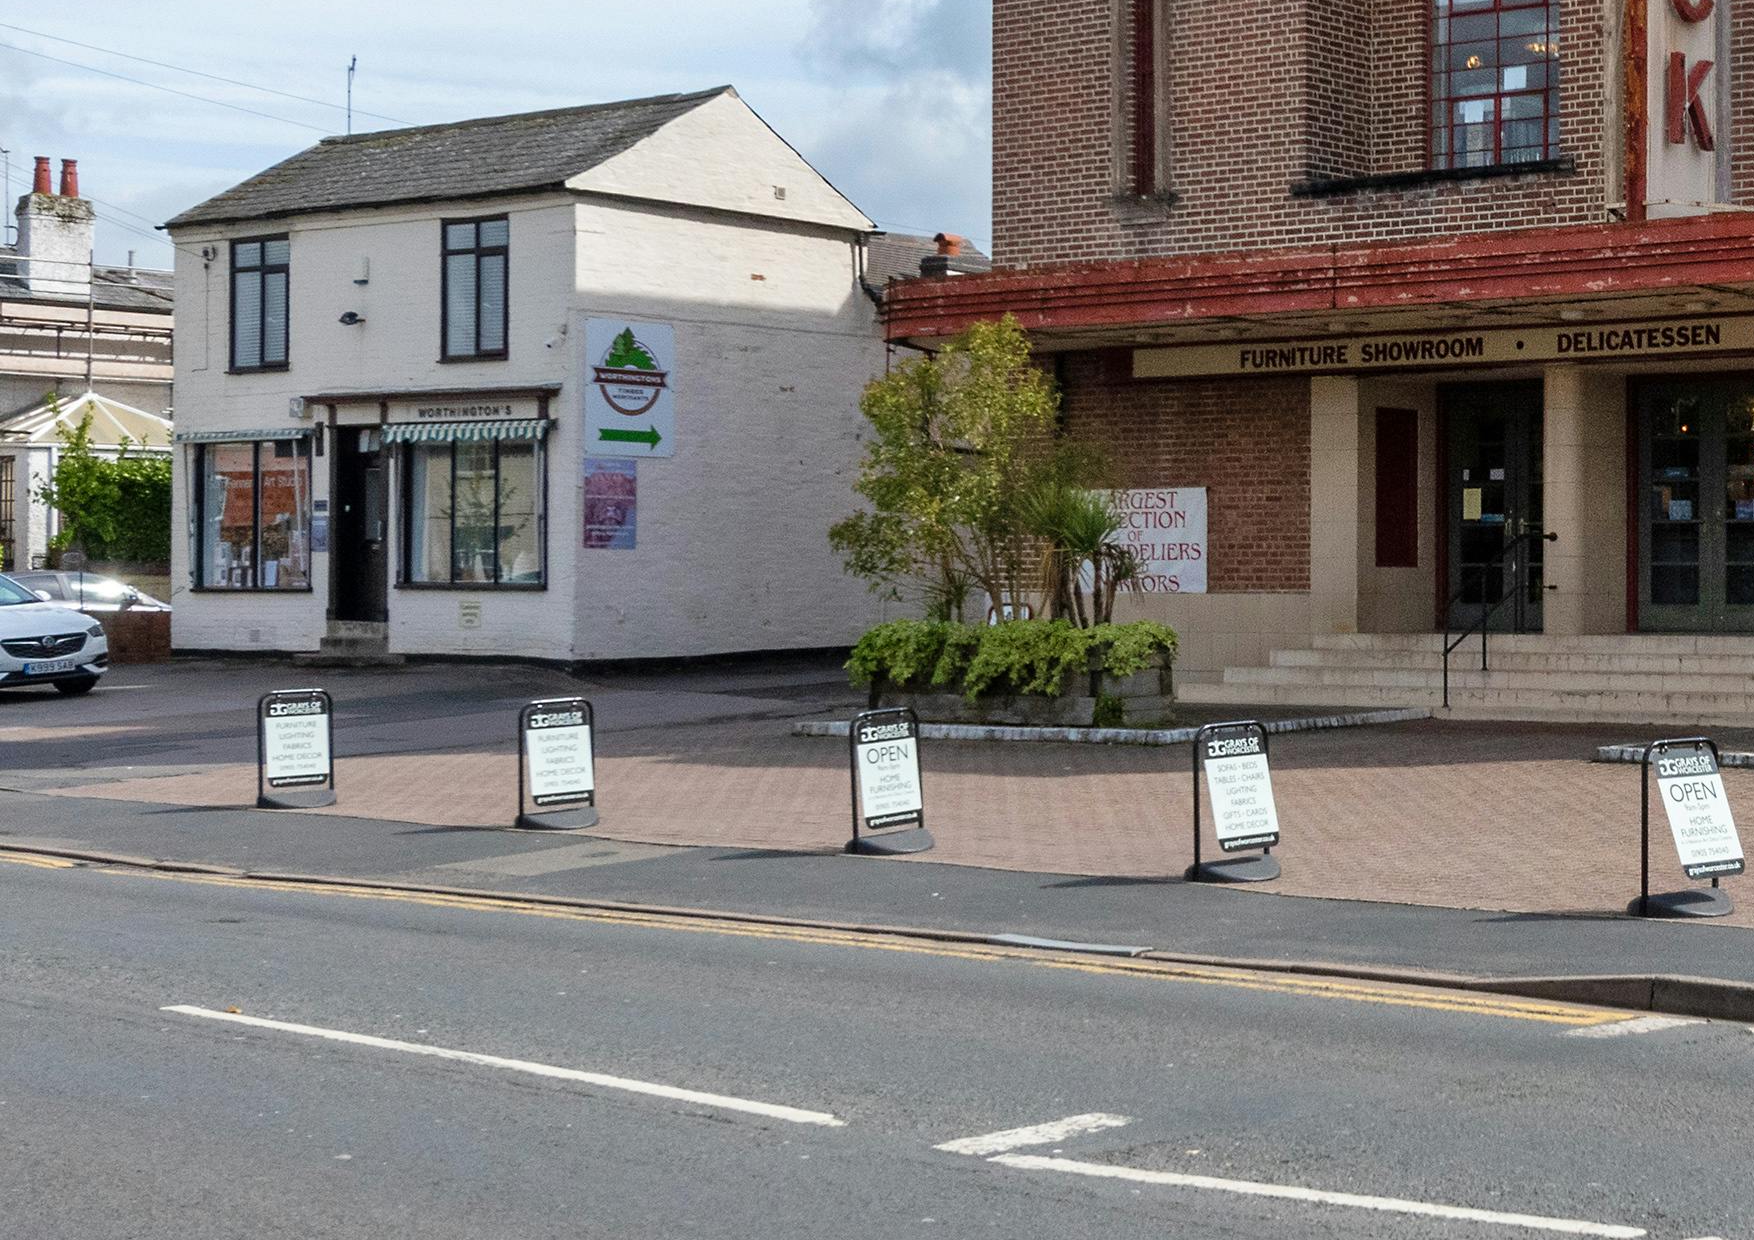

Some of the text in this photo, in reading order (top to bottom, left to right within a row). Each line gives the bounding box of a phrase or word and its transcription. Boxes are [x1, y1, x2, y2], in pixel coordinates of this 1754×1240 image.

[1240, 344, 1348, 369] FURNITURE
[1361, 337, 1484, 362] SHOWROOM
[1557, 324, 1721, 353] DELICATESSEN
[1127, 530, 1143, 543] OF
[1224, 736, 1258, 748] GRAYS OF
[867, 744, 909, 764] OPEN
[1674, 755, 1710, 768] GRAYS OF
[1670, 780, 1717, 802] OPEN
[1689, 815, 1713, 826] HOME
